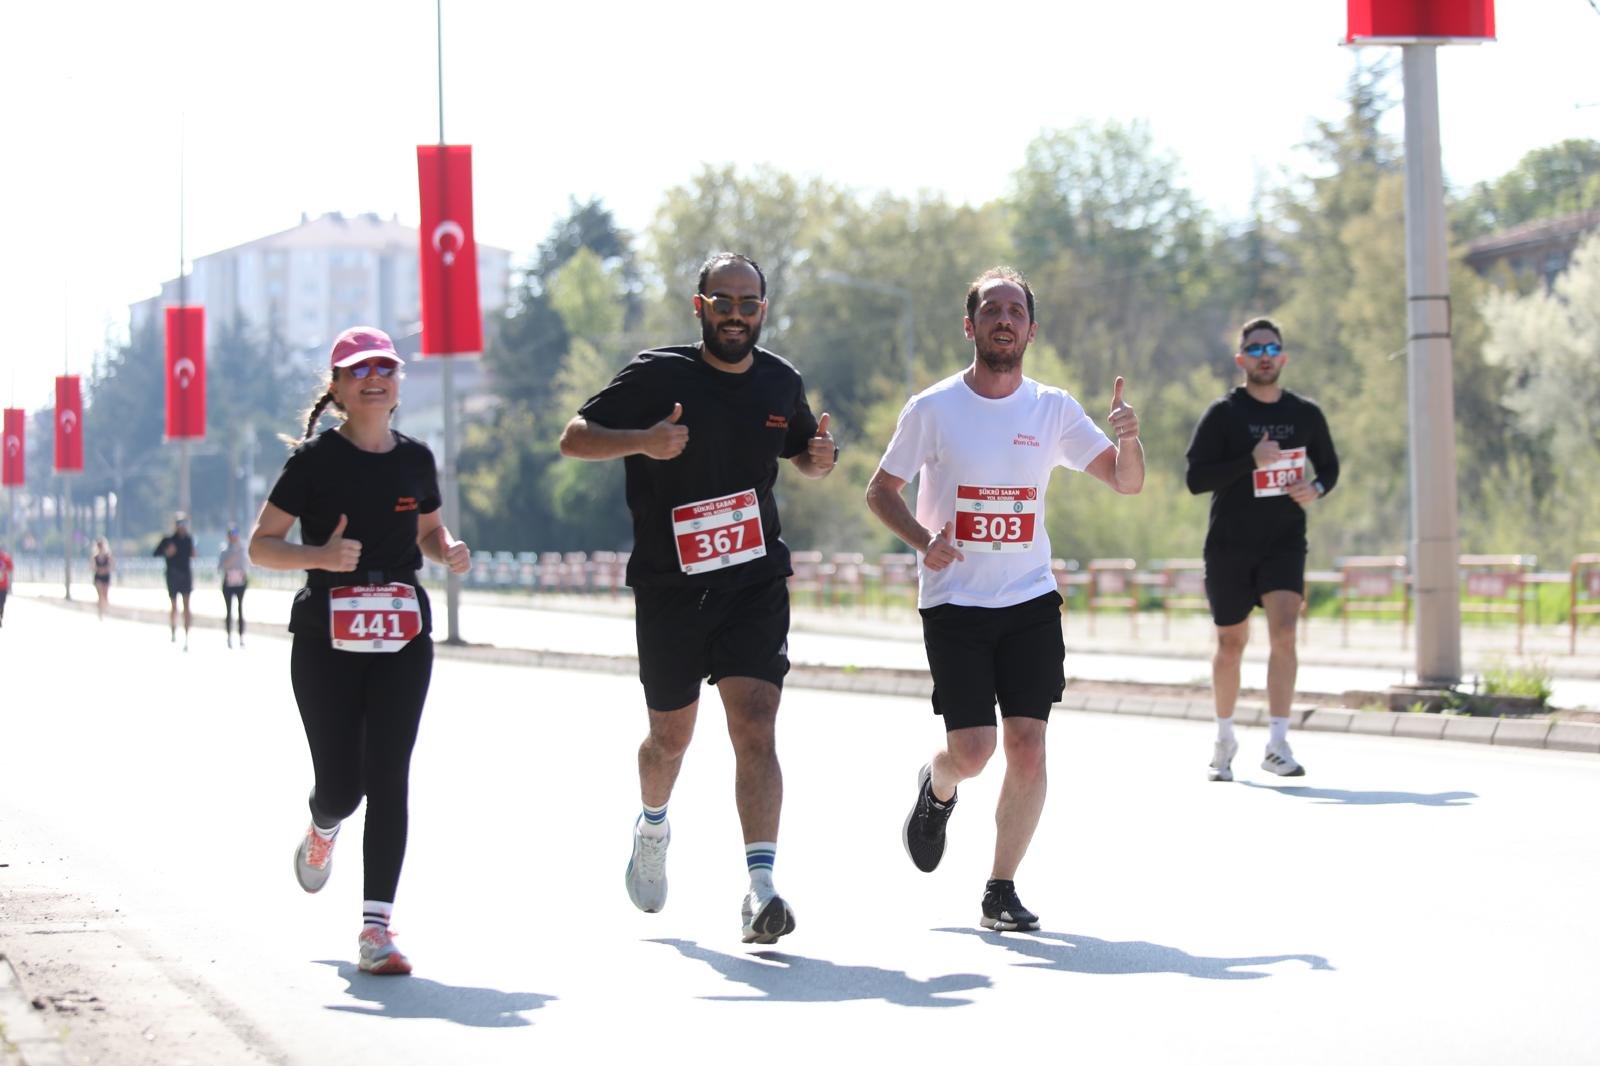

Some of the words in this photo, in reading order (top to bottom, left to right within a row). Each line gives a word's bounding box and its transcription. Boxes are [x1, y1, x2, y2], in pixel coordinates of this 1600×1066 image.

[1248, 424, 1295, 435] WATCH
[1266, 469, 1297, 487] 180
[971, 515, 1022, 540] 303
[695, 524, 745, 558] 367
[349, 613, 405, 638] 441
